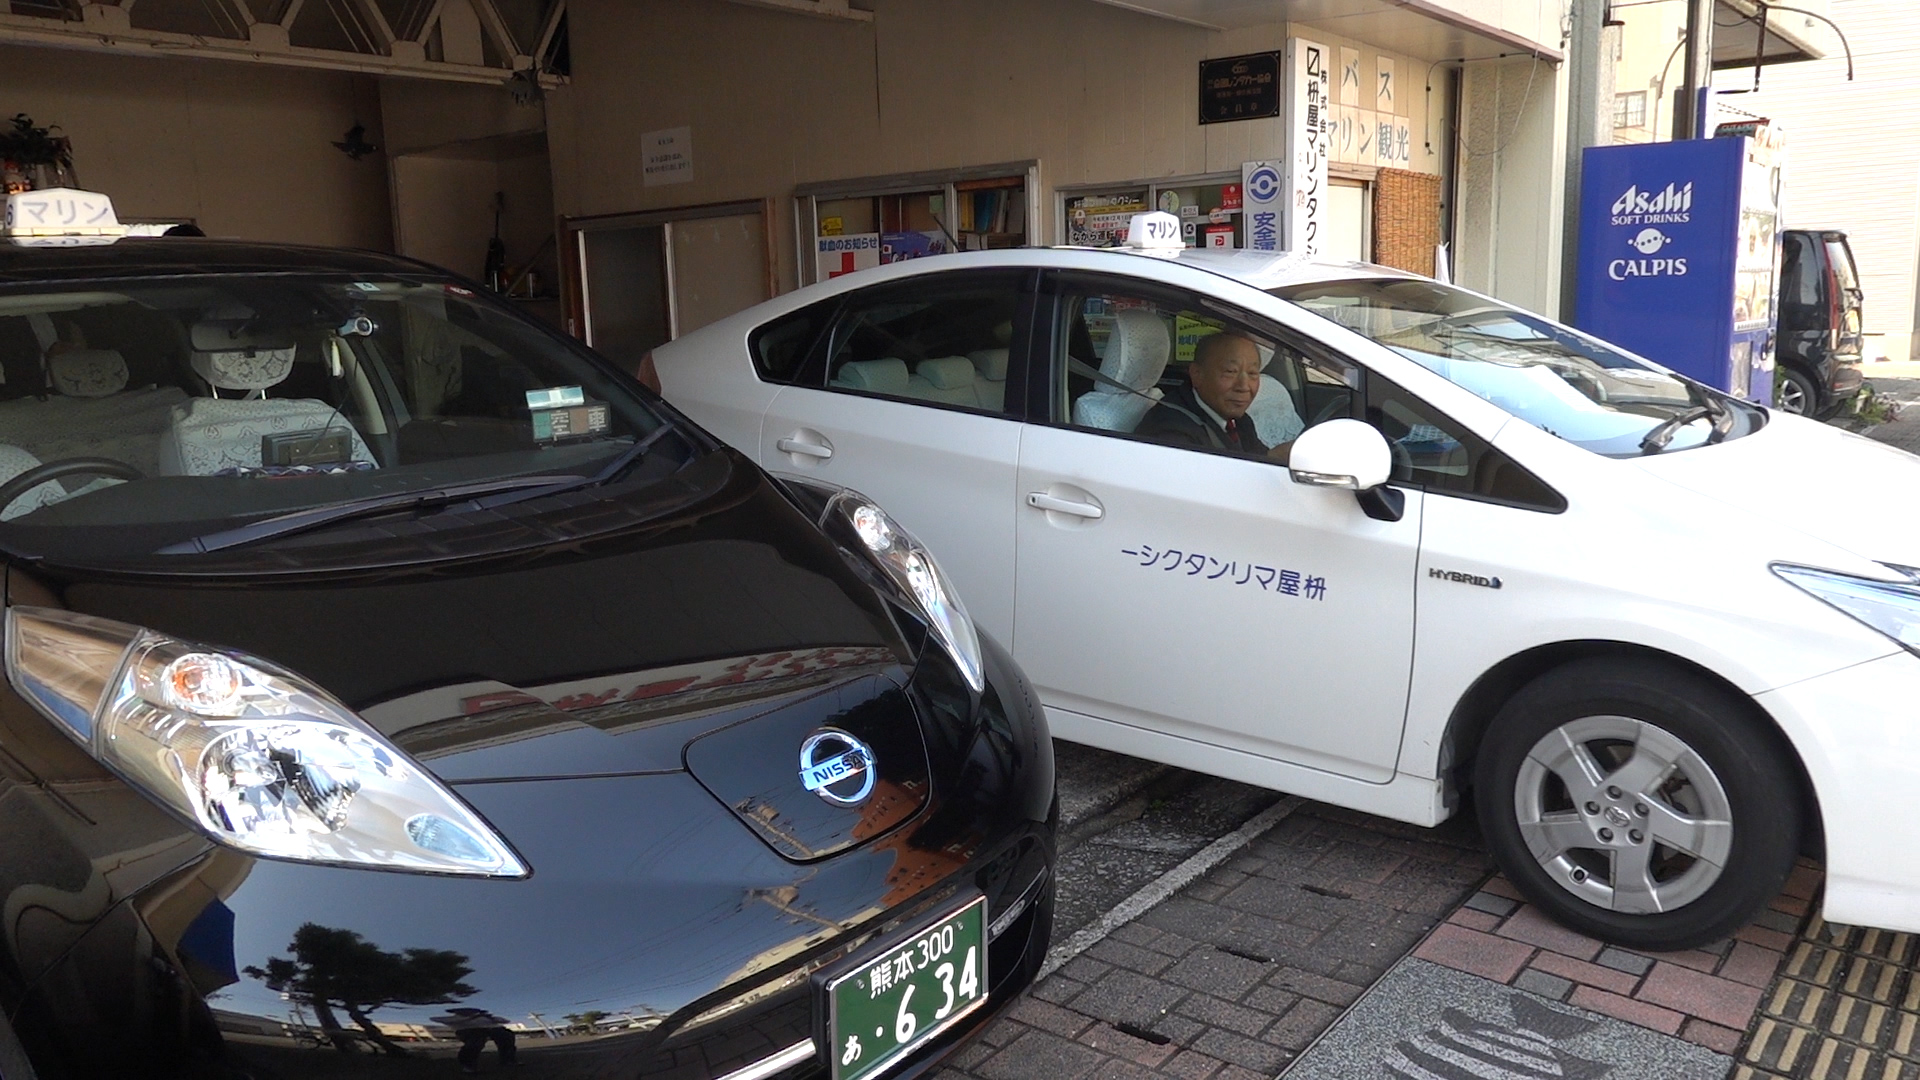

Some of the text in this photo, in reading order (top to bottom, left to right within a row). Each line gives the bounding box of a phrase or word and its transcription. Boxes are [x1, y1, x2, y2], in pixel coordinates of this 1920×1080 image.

[1342, 58, 1391, 101] バス
[1328, 116, 1409, 161] マリン観光
[1611, 181, 1692, 215] Asahi
[22, 199, 108, 225] マリン
[1611, 212, 1690, 226] SOFT DRINKS
[1147, 221, 1178, 239] マリン
[819, 238, 878, 252] 献血のお知らせ
[1608, 258, 1687, 281] CALPIS
[1429, 567, 1490, 588] HYBRID
[812, 747, 871, 783] NISSAN
[842, 1035, 862, 1066] あ
